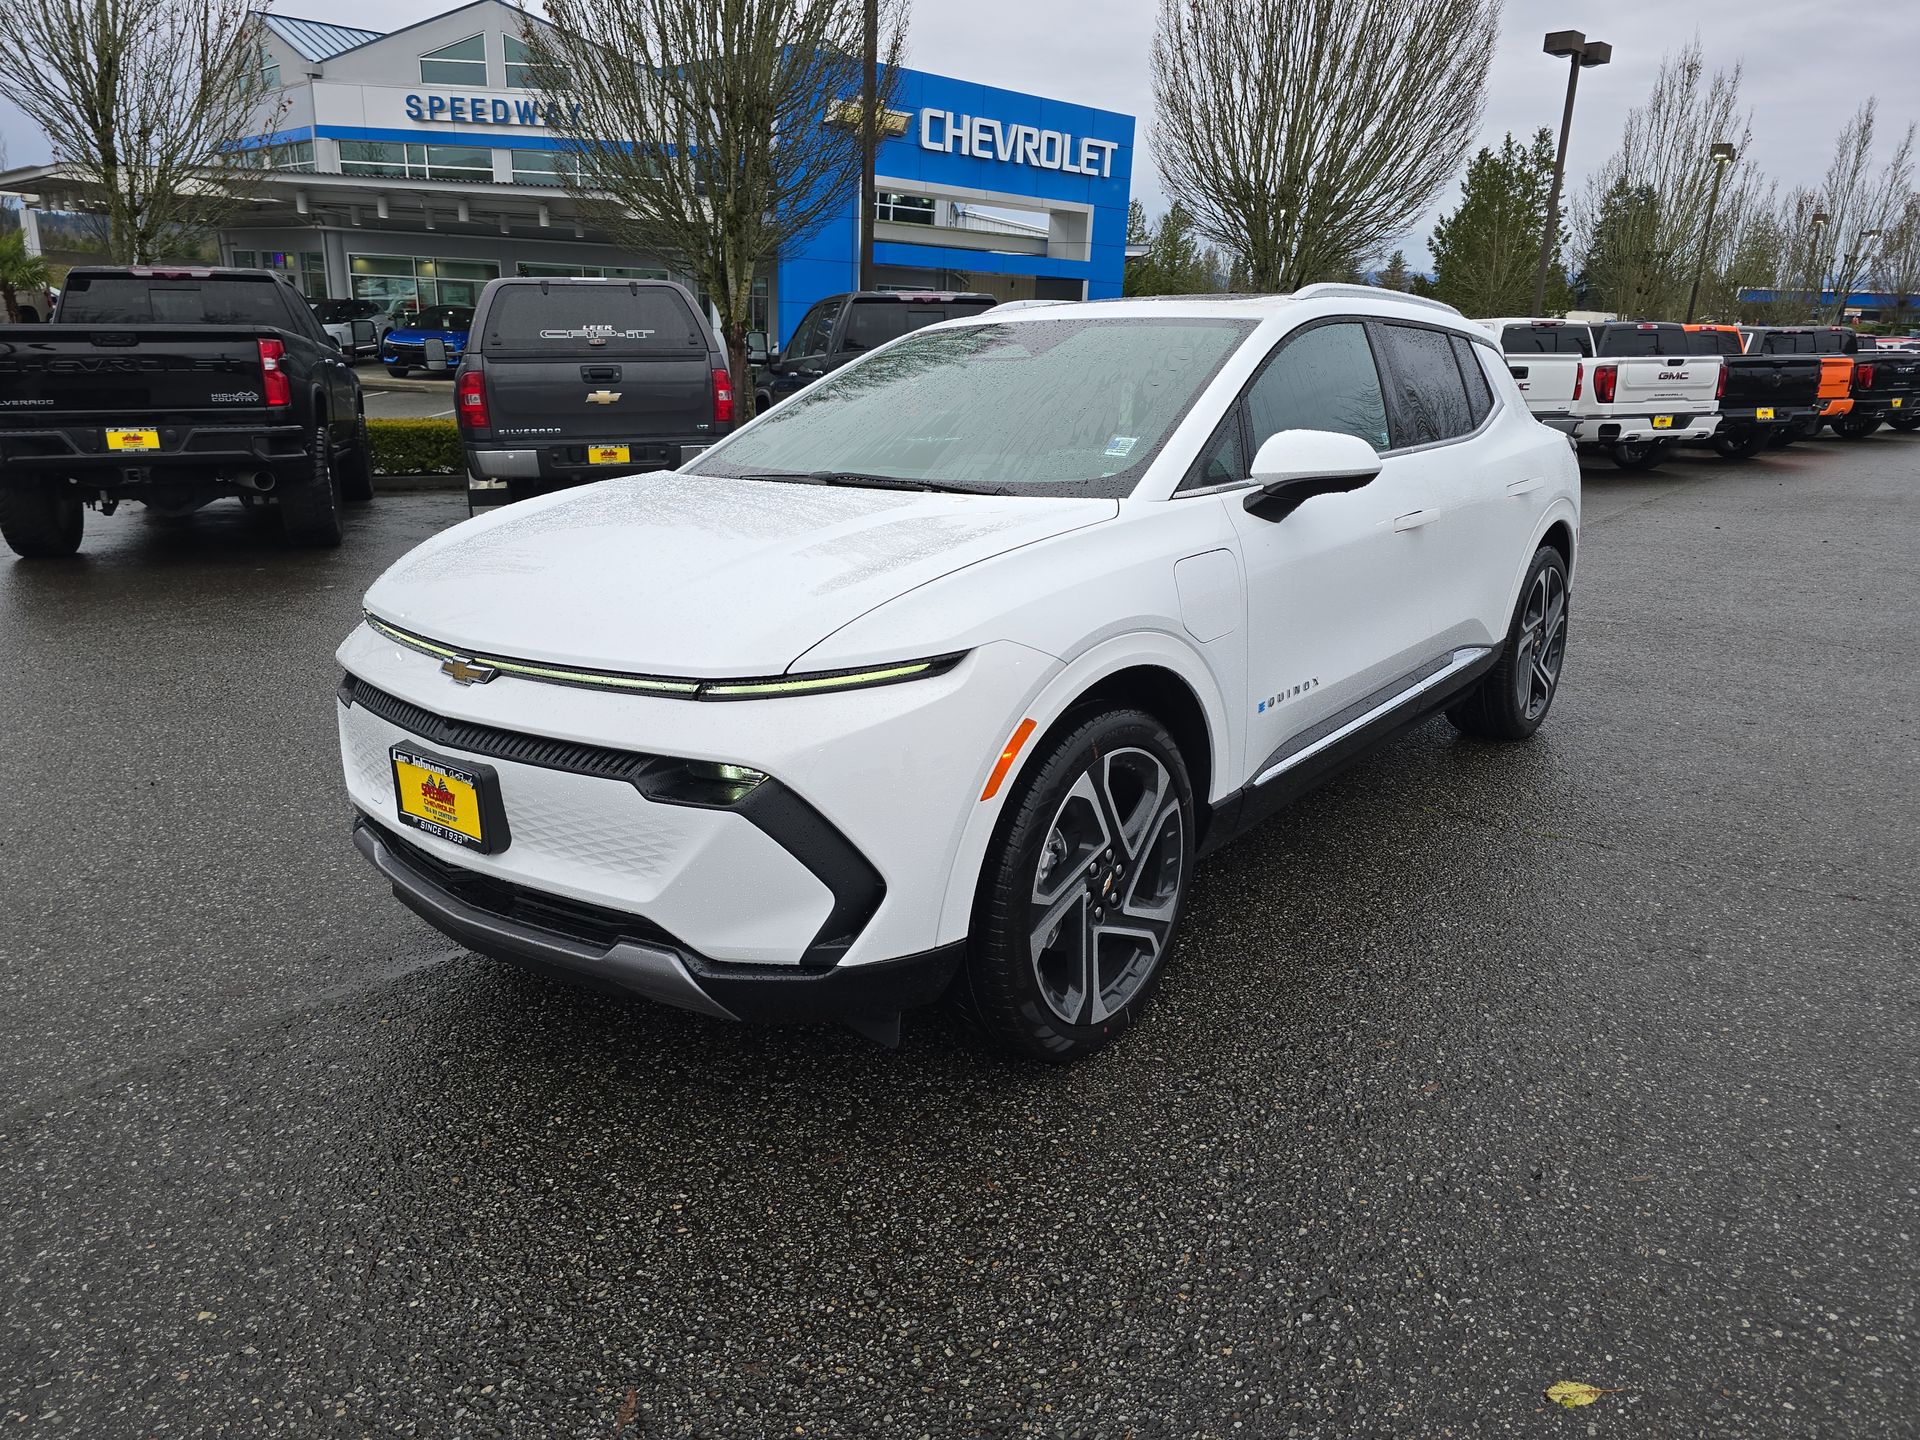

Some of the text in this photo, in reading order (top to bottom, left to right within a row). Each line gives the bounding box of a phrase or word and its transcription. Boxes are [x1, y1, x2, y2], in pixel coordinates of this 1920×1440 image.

[405, 94, 581, 126] SPEEDWAY
[919, 107, 1119, 178] CHEVROLET
[1658, 371, 1690, 380] GMC
[1258, 677, 1319, 713] EQUINOX
[421, 782, 456, 807] SPEEDWAY
[423, 798, 456, 815] CHEVROLET
[420, 821, 464, 844] SINCE 1933
